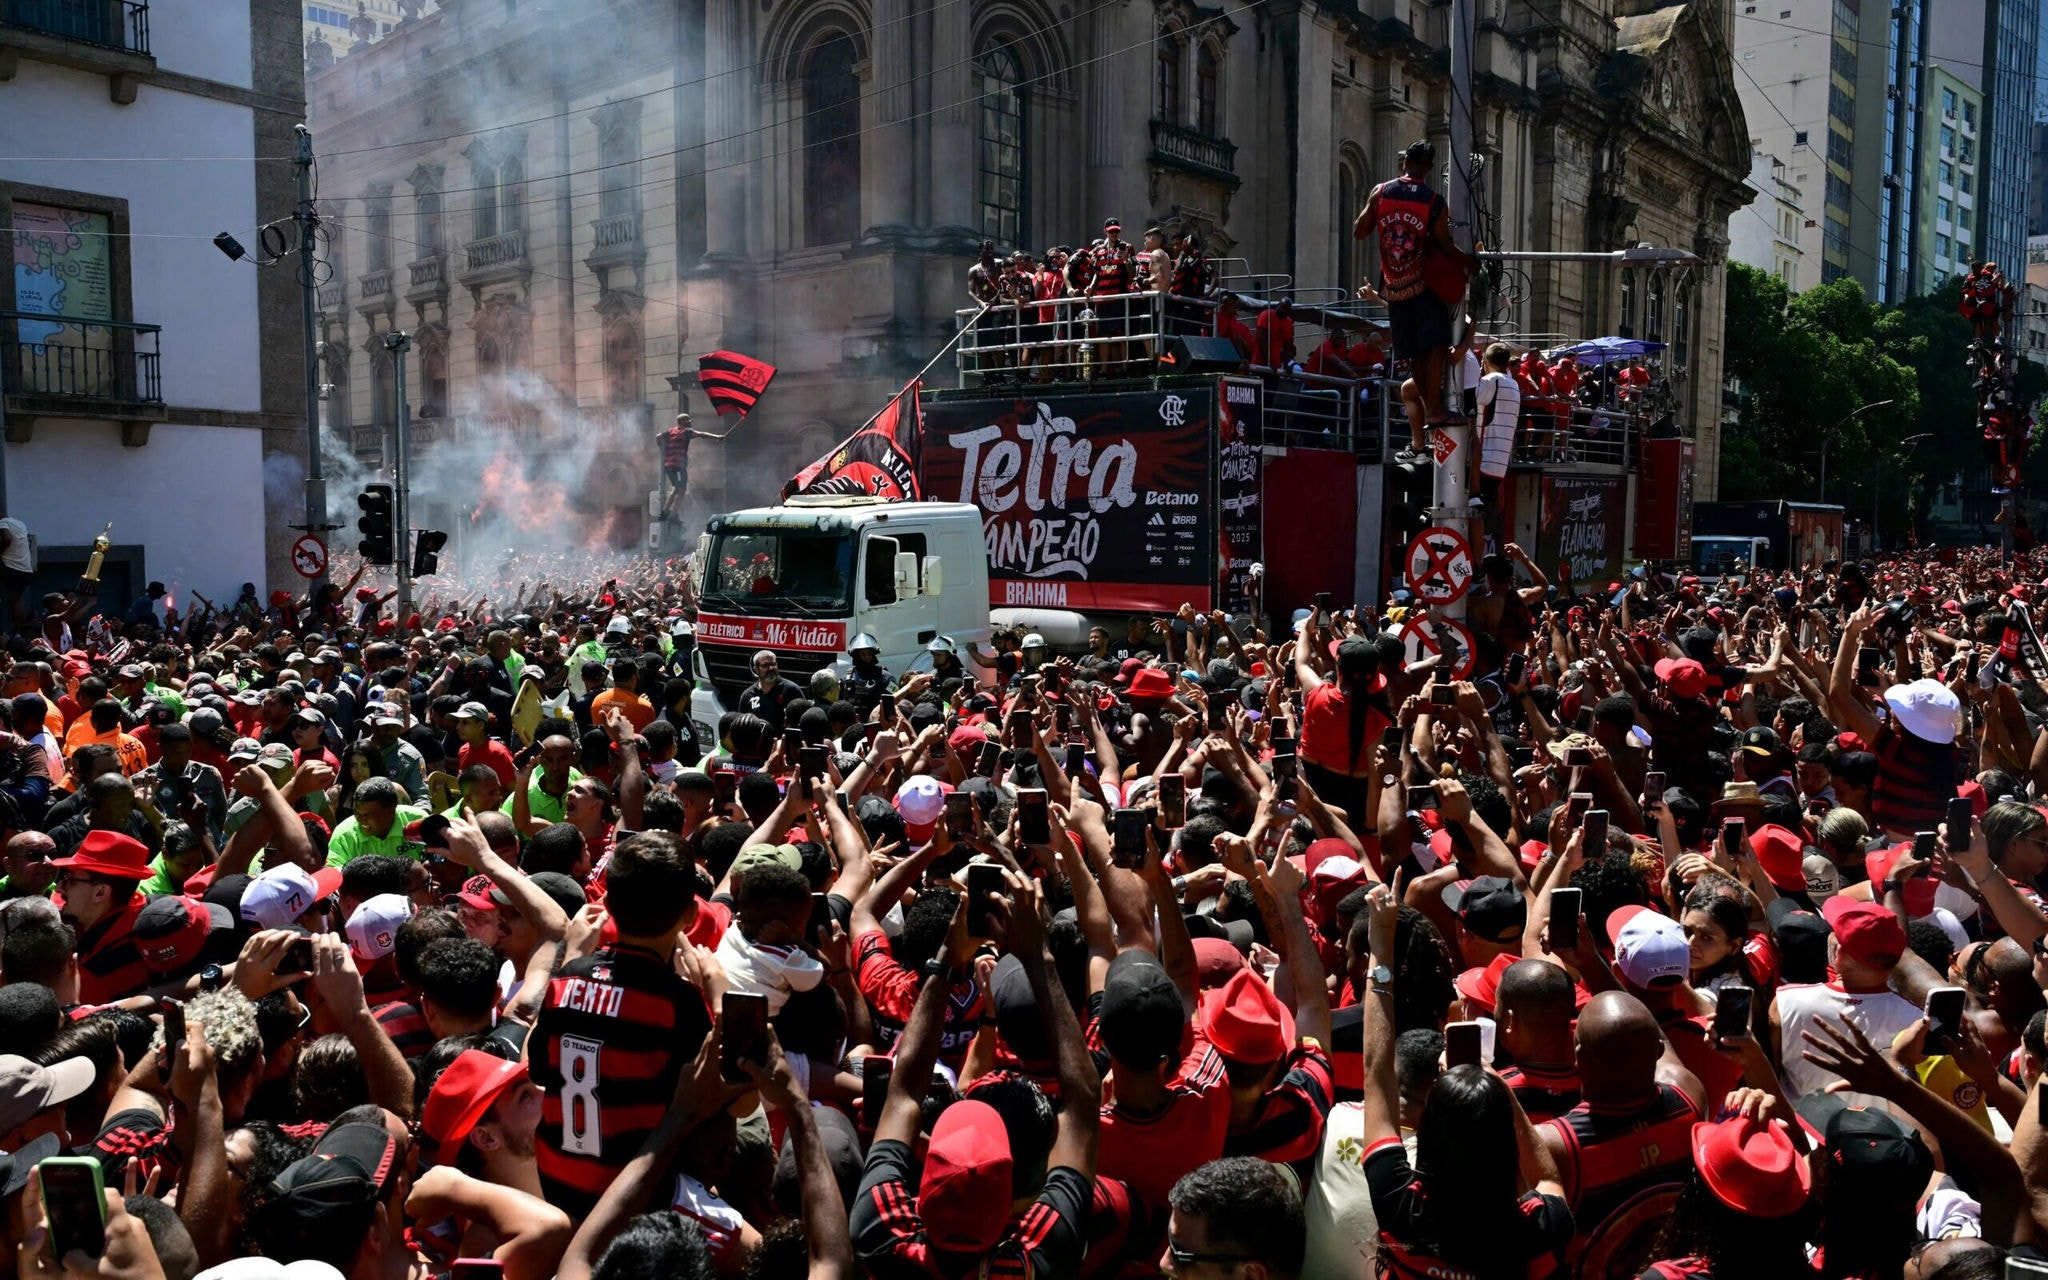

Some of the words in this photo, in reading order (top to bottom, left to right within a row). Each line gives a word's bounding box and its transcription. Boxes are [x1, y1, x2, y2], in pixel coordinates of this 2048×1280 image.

[1227, 386, 1255, 404] BRAHMA
[949, 402, 1137, 513] Tetra
[1230, 440, 1250, 457] Tetra
[1221, 456, 1257, 481] CAMPEÃO
[1145, 491, 1199, 505] Betano
[1180, 515, 1197, 525] BRB
[982, 511, 1100, 578] AMPEÃO
[1231, 533, 1250, 543] 2025
[1560, 522, 1606, 558] FLAMENGO
[1005, 581, 1067, 607] BRAHMA
[709, 622, 745, 639] ELÉTRICO
[766, 623, 788, 645] Mó
[791, 624, 838, 647] Vidão
[750, 696, 760, 710] 12
[722, 762, 760, 774] DIRETORI
[286, 892, 304, 913] 77
[559, 978, 624, 1018] BENTO
[571, 1041, 596, 1053] TEXACO
[560, 1032, 604, 1158] 8
